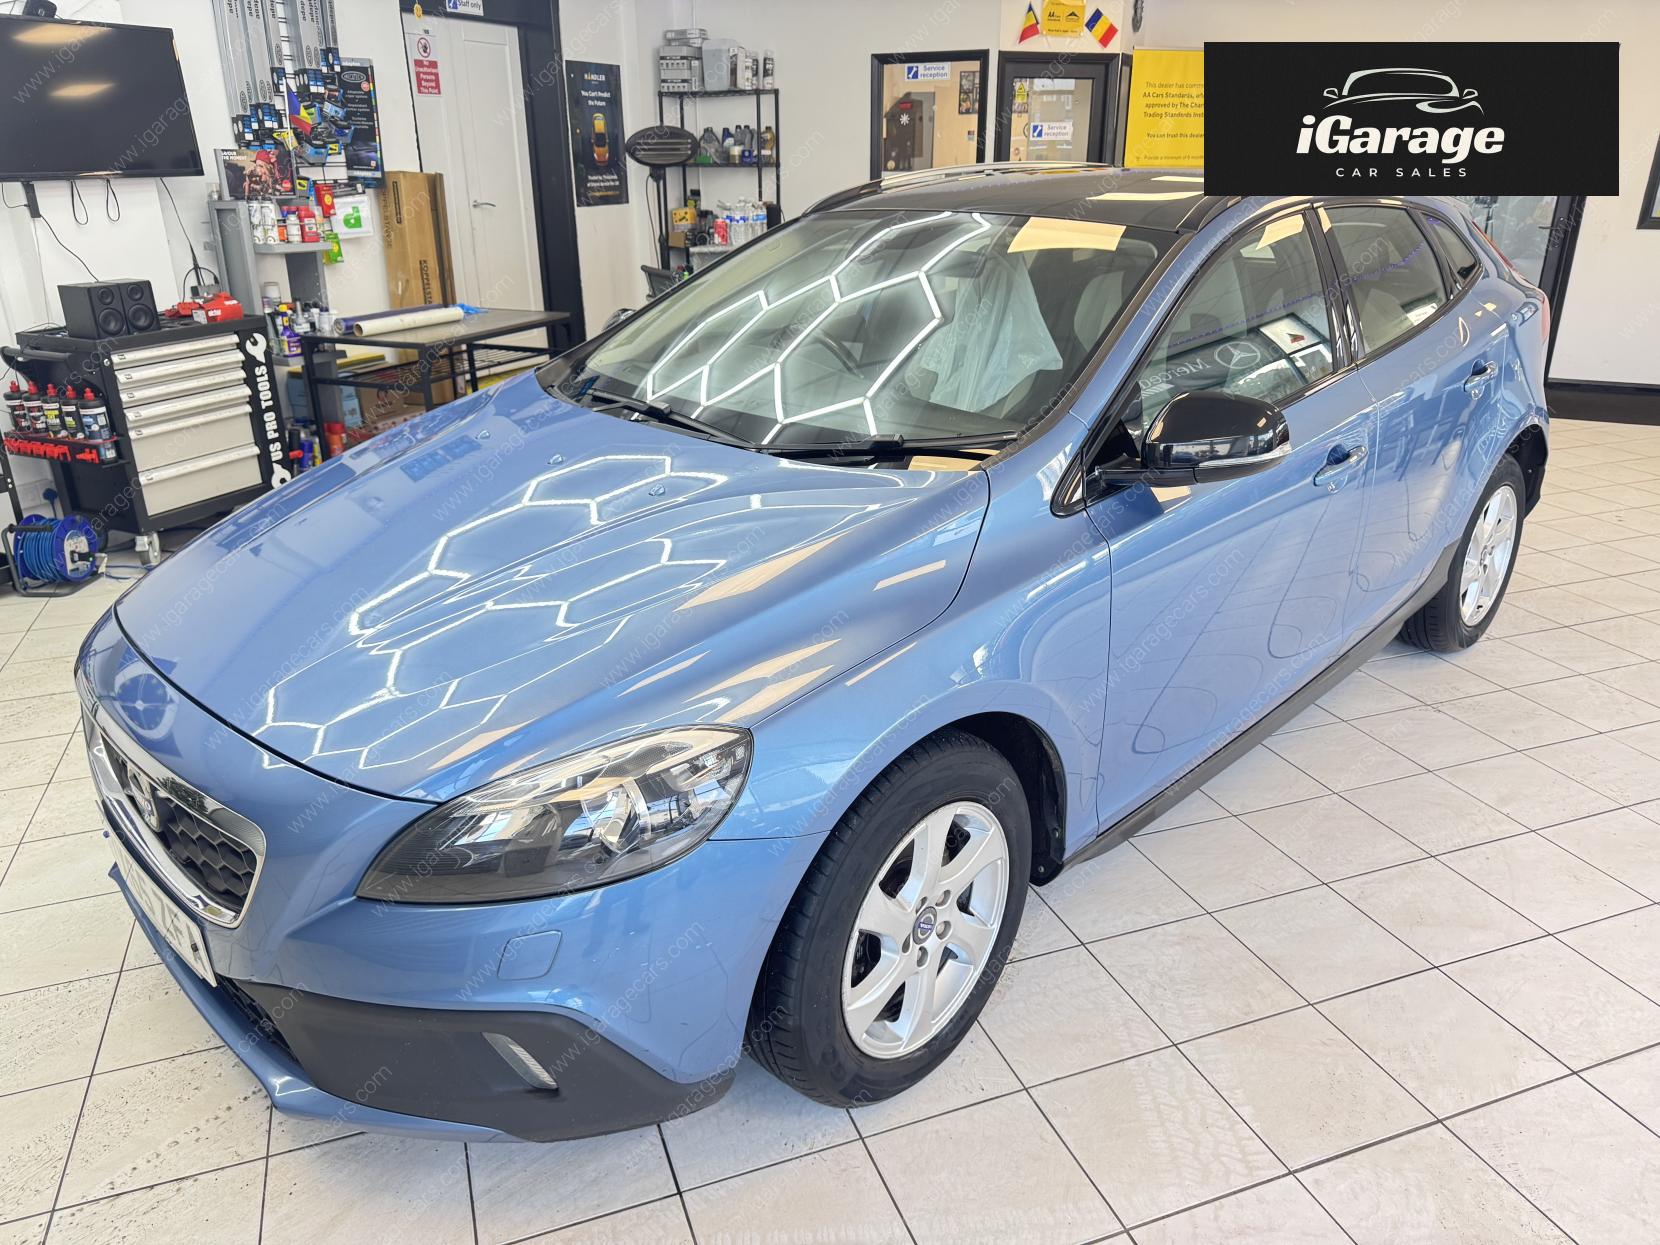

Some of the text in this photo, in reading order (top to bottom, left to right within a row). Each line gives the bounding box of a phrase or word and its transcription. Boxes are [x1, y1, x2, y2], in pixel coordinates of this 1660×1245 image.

[422, 259, 433, 304] KOPPELSTA
[254, 364, 283, 462] US PRO TOOLS
